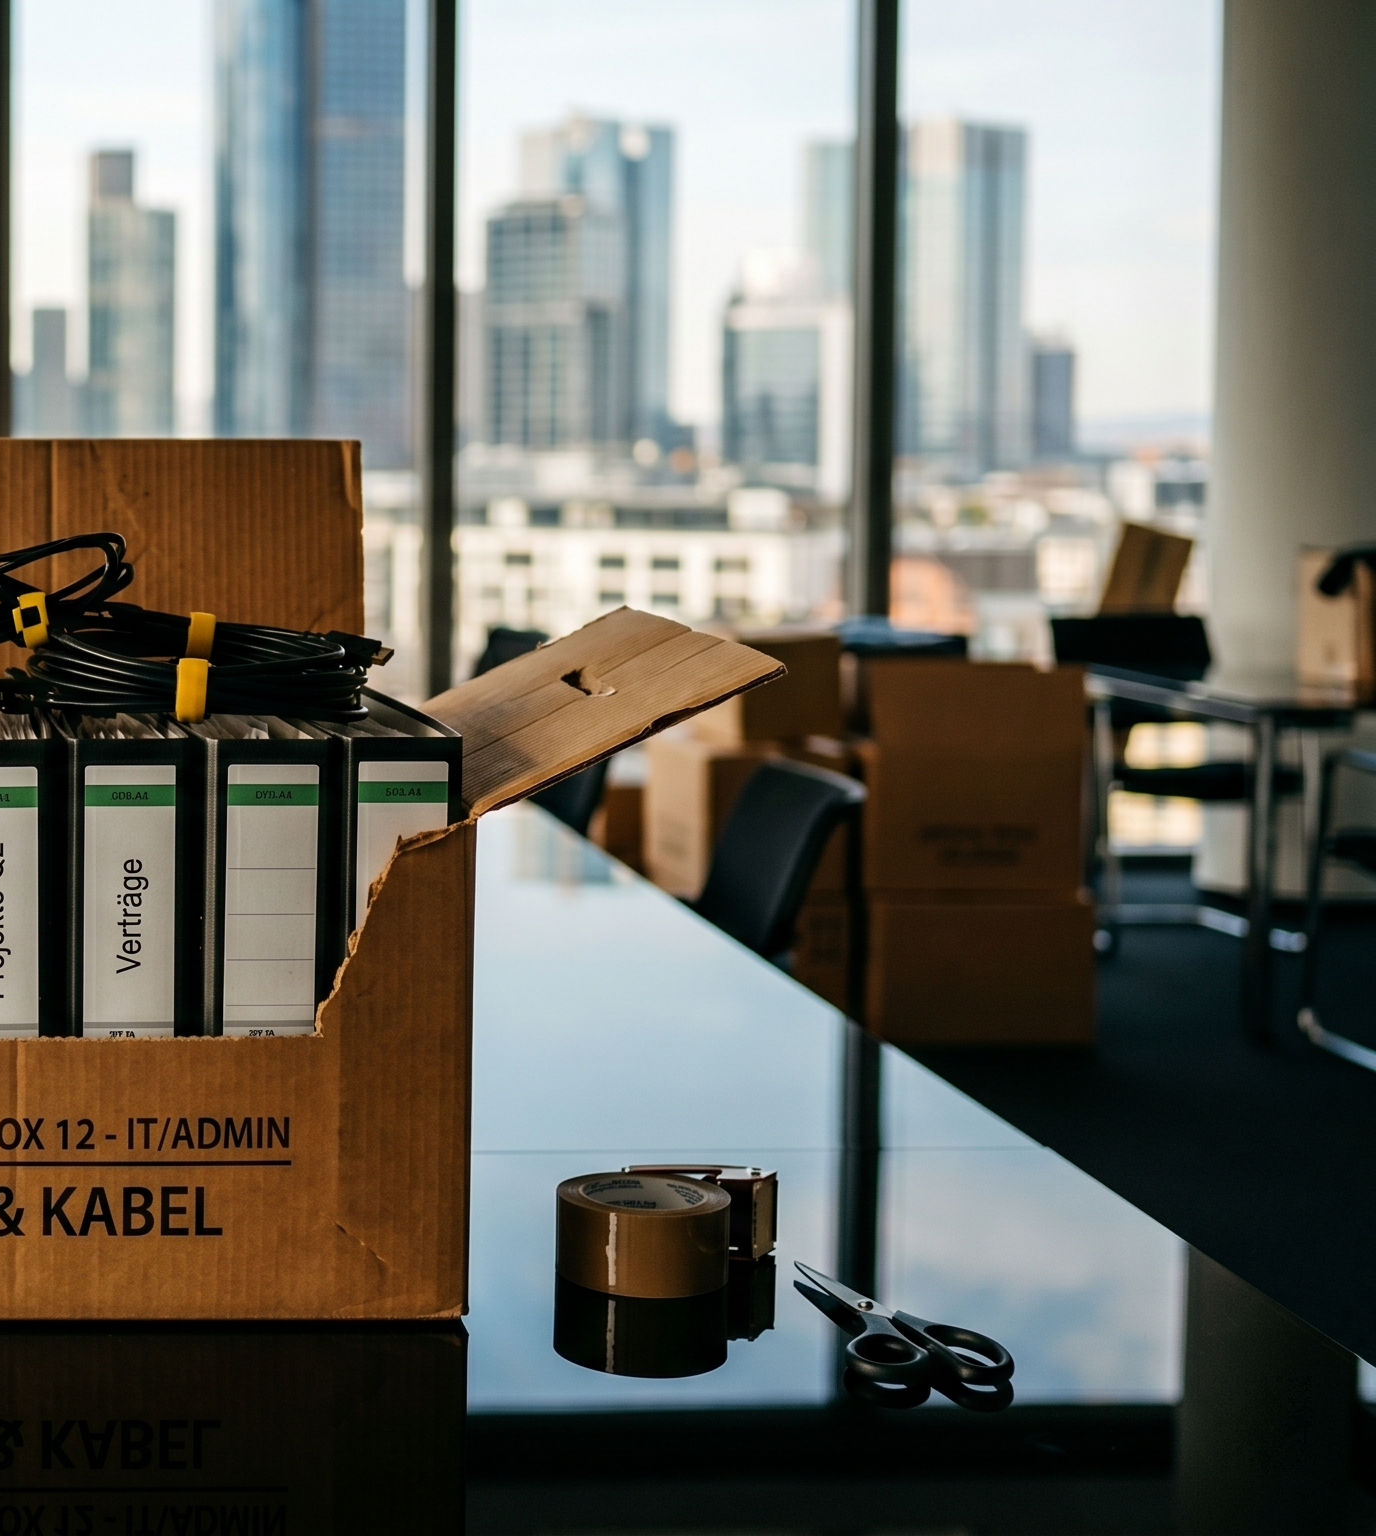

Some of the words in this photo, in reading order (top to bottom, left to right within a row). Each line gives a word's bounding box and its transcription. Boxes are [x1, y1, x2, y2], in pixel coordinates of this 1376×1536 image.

[116, 858, 149, 974] Verträge
[56, 1118, 95, 1150] 12
[128, 1116, 290, 1152] IT/ADMIN
[42, 1186, 223, 1237] KABEL
